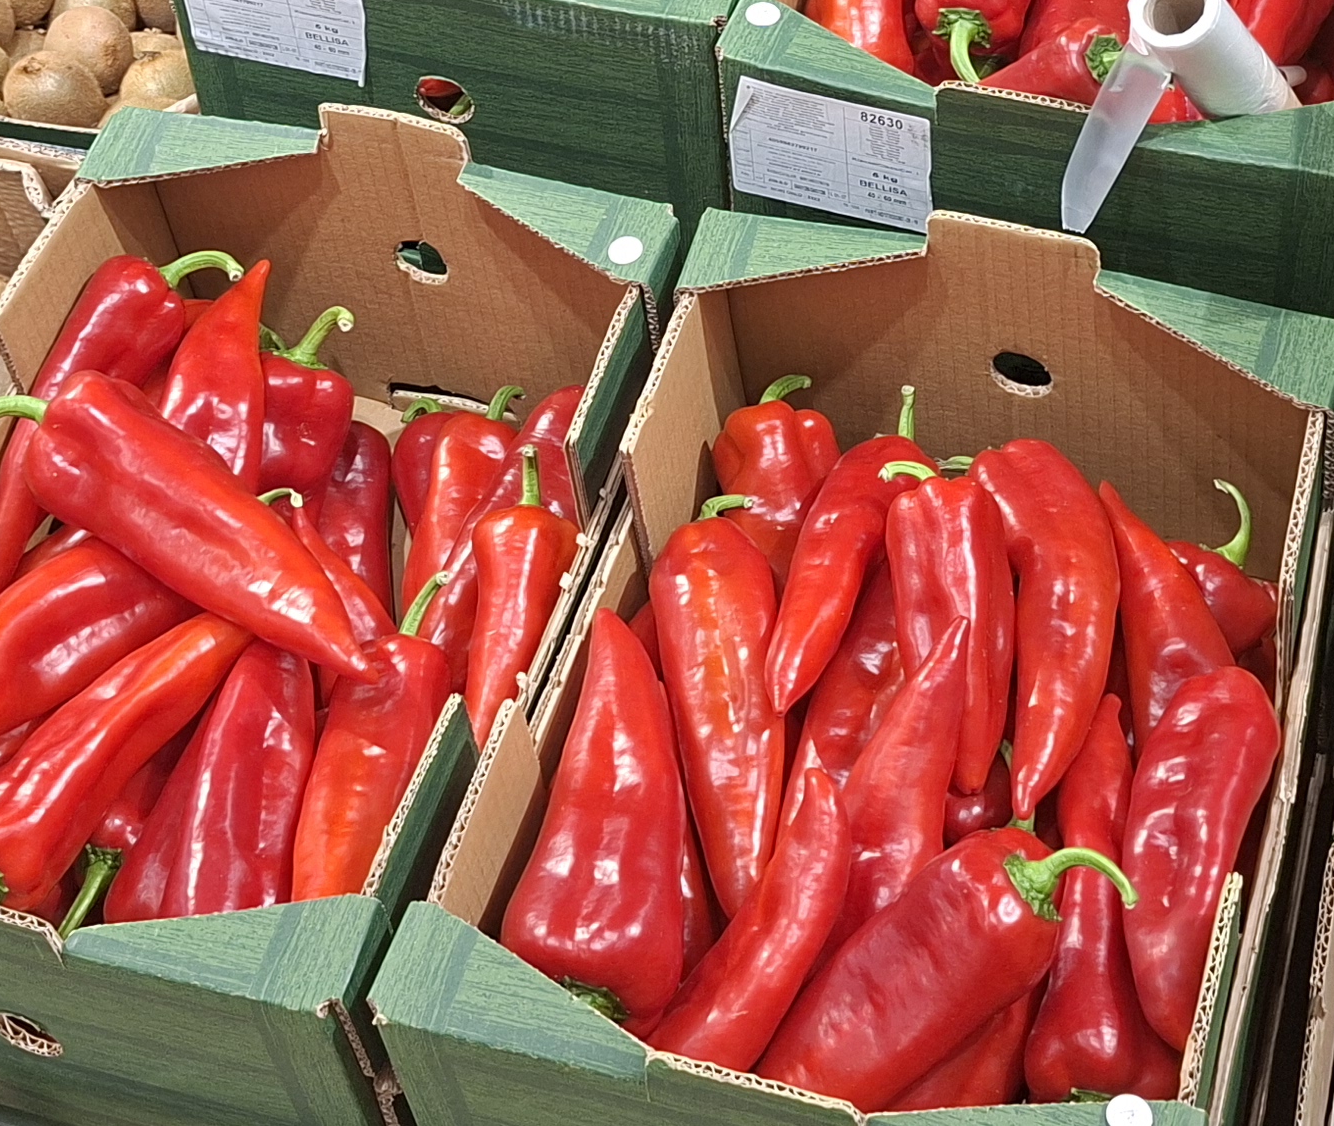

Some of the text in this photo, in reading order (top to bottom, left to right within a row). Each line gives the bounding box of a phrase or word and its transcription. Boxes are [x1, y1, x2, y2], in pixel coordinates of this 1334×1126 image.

[305, 31, 350, 47] BELLISA
[860, 111, 903, 130] 82630
[860, 179, 908, 197] BELLISA
